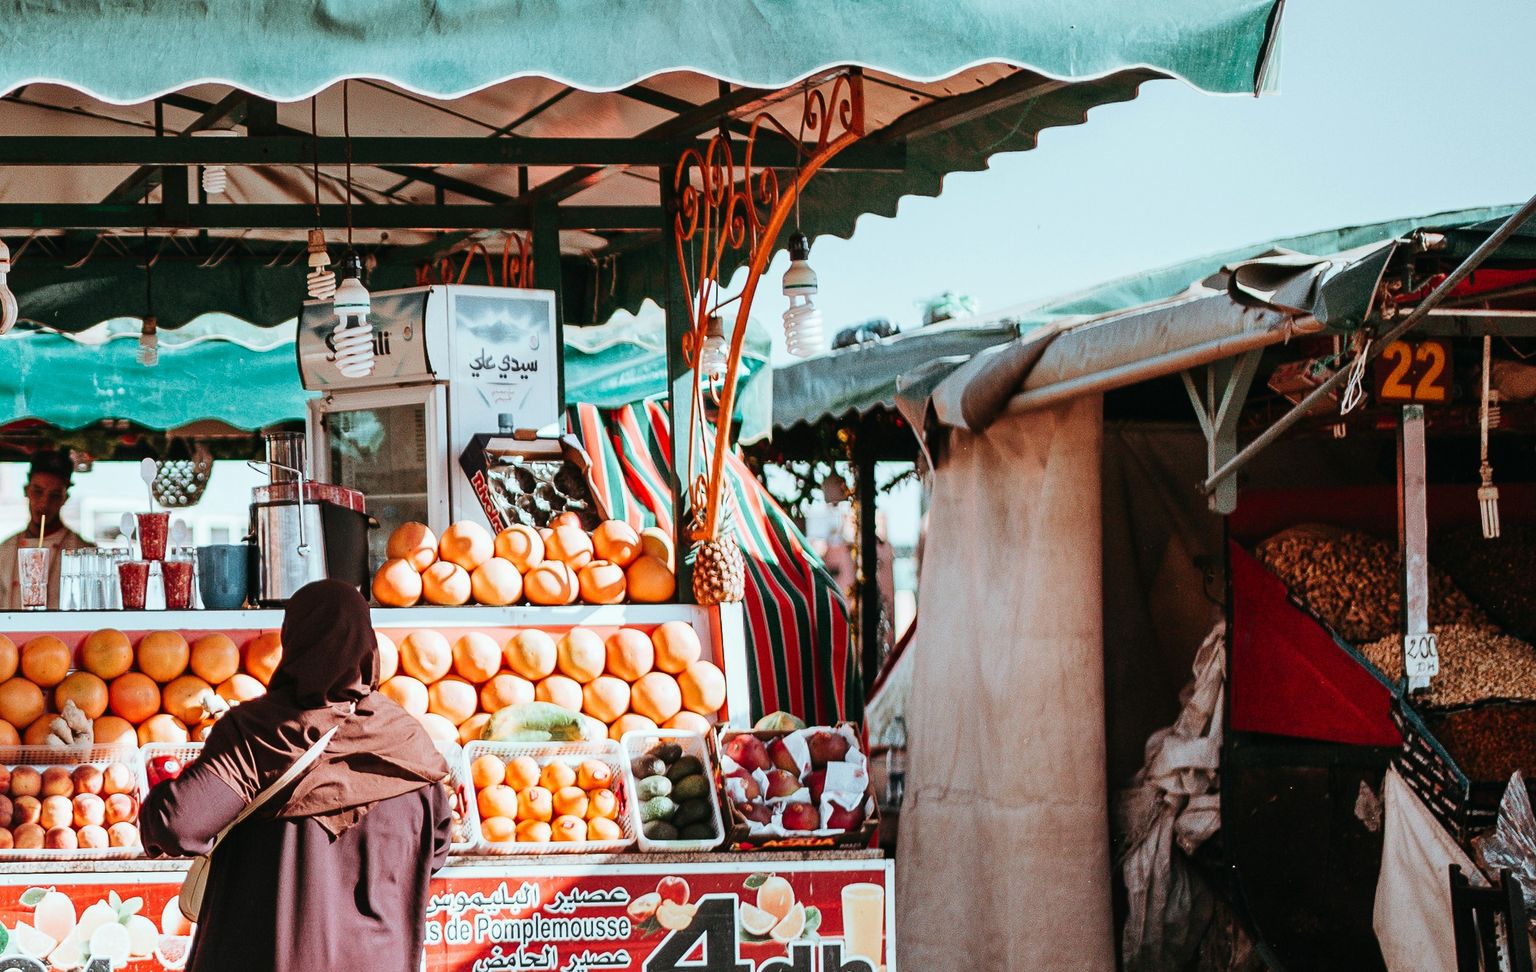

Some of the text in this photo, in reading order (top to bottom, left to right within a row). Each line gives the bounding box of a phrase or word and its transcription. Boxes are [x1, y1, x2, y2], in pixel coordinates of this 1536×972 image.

[469, 347, 539, 380] سيدي علي
[1381, 340, 1445, 400] 22
[547, 885, 630, 913] عصير
[447, 917, 470, 942] de
[477, 915, 630, 944] Pomplemousse
[474, 946, 557, 972] الحامض
